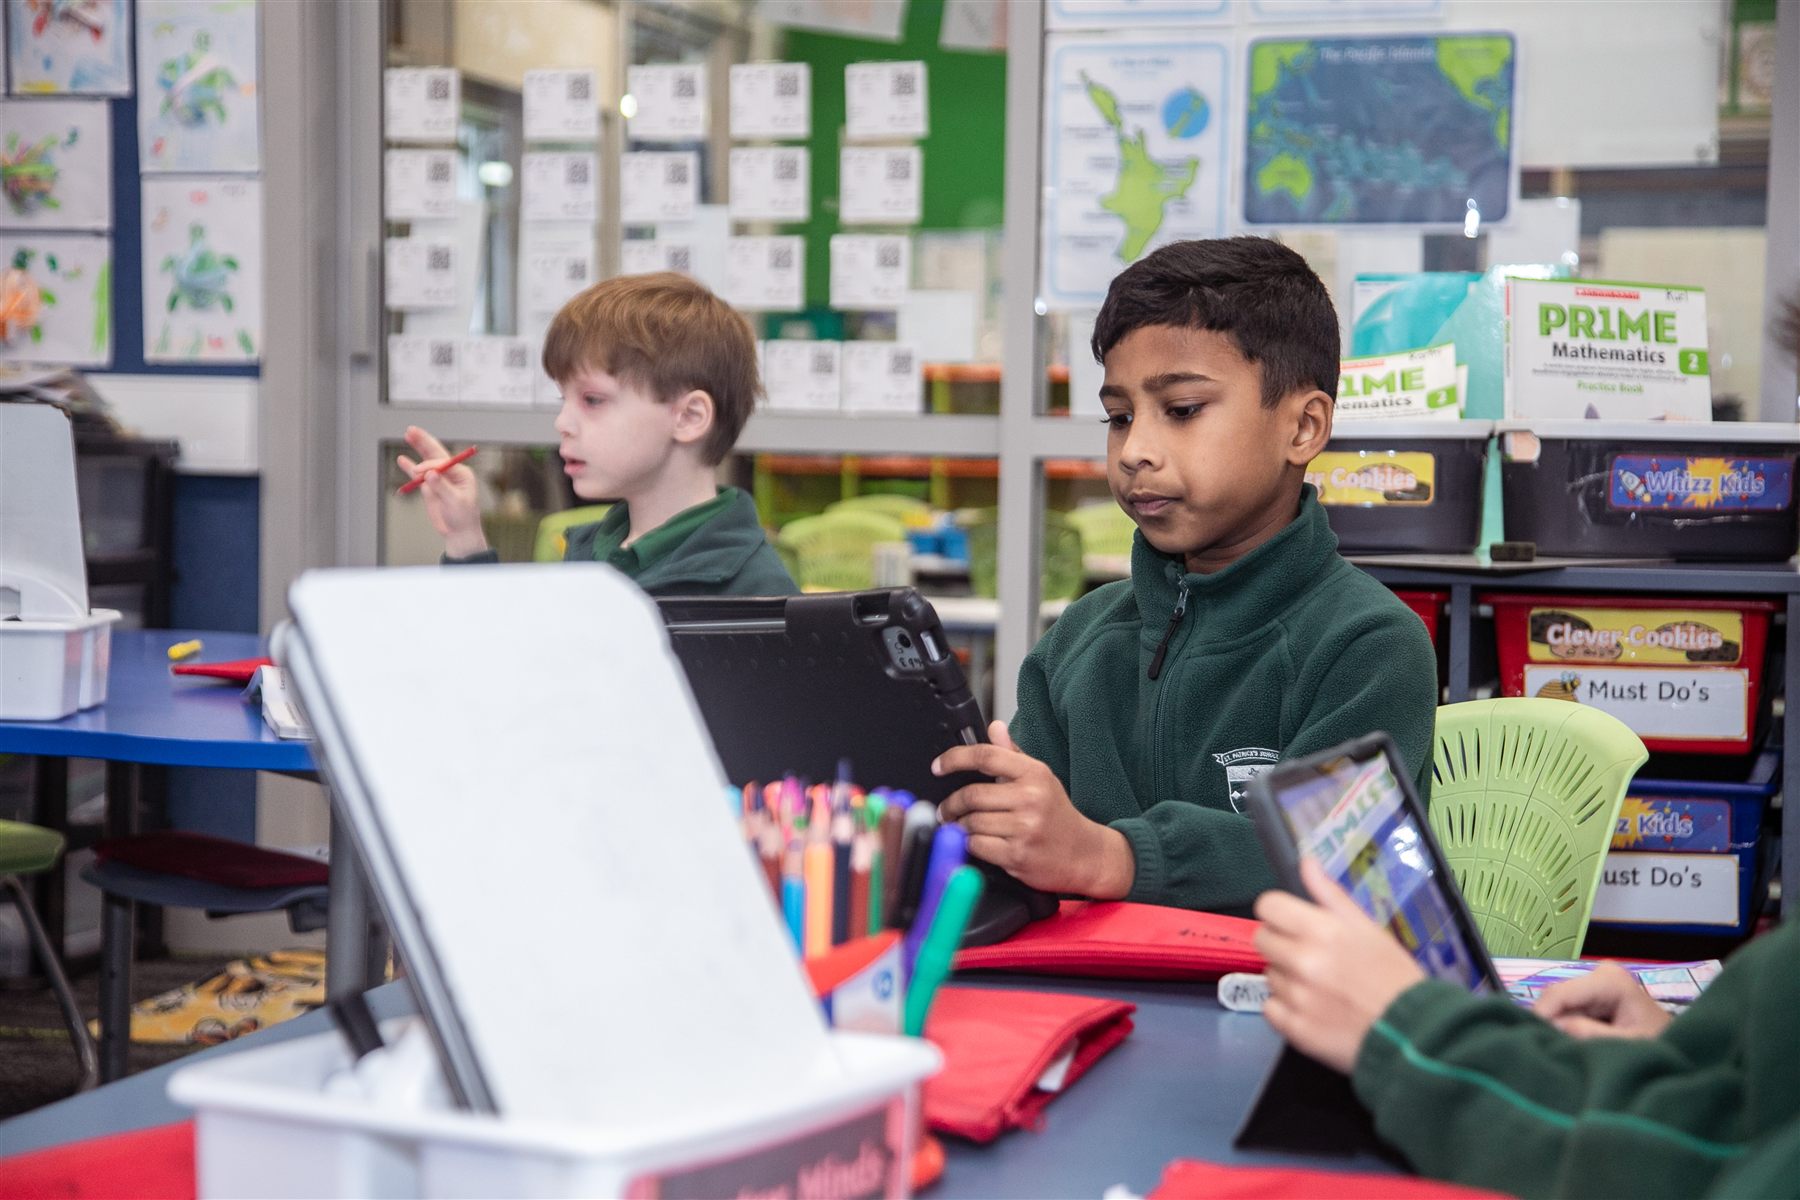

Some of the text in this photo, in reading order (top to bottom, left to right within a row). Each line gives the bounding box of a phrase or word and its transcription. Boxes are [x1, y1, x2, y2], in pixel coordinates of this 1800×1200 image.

[1552, 341, 1666, 364] Mathematics
[1687, 353, 1699, 371] 2
[1577, 380, 1644, 395] Practice Book
[1330, 467, 1418, 491] Cookies
[1645, 471, 1765, 496] Whizz Kids
[1547, 622, 1724, 650] Clever Cookies
[1588, 679, 1710, 702] Must Do's
[1637, 811, 1694, 838] Kids
[1601, 865, 1703, 888] ust Do's
